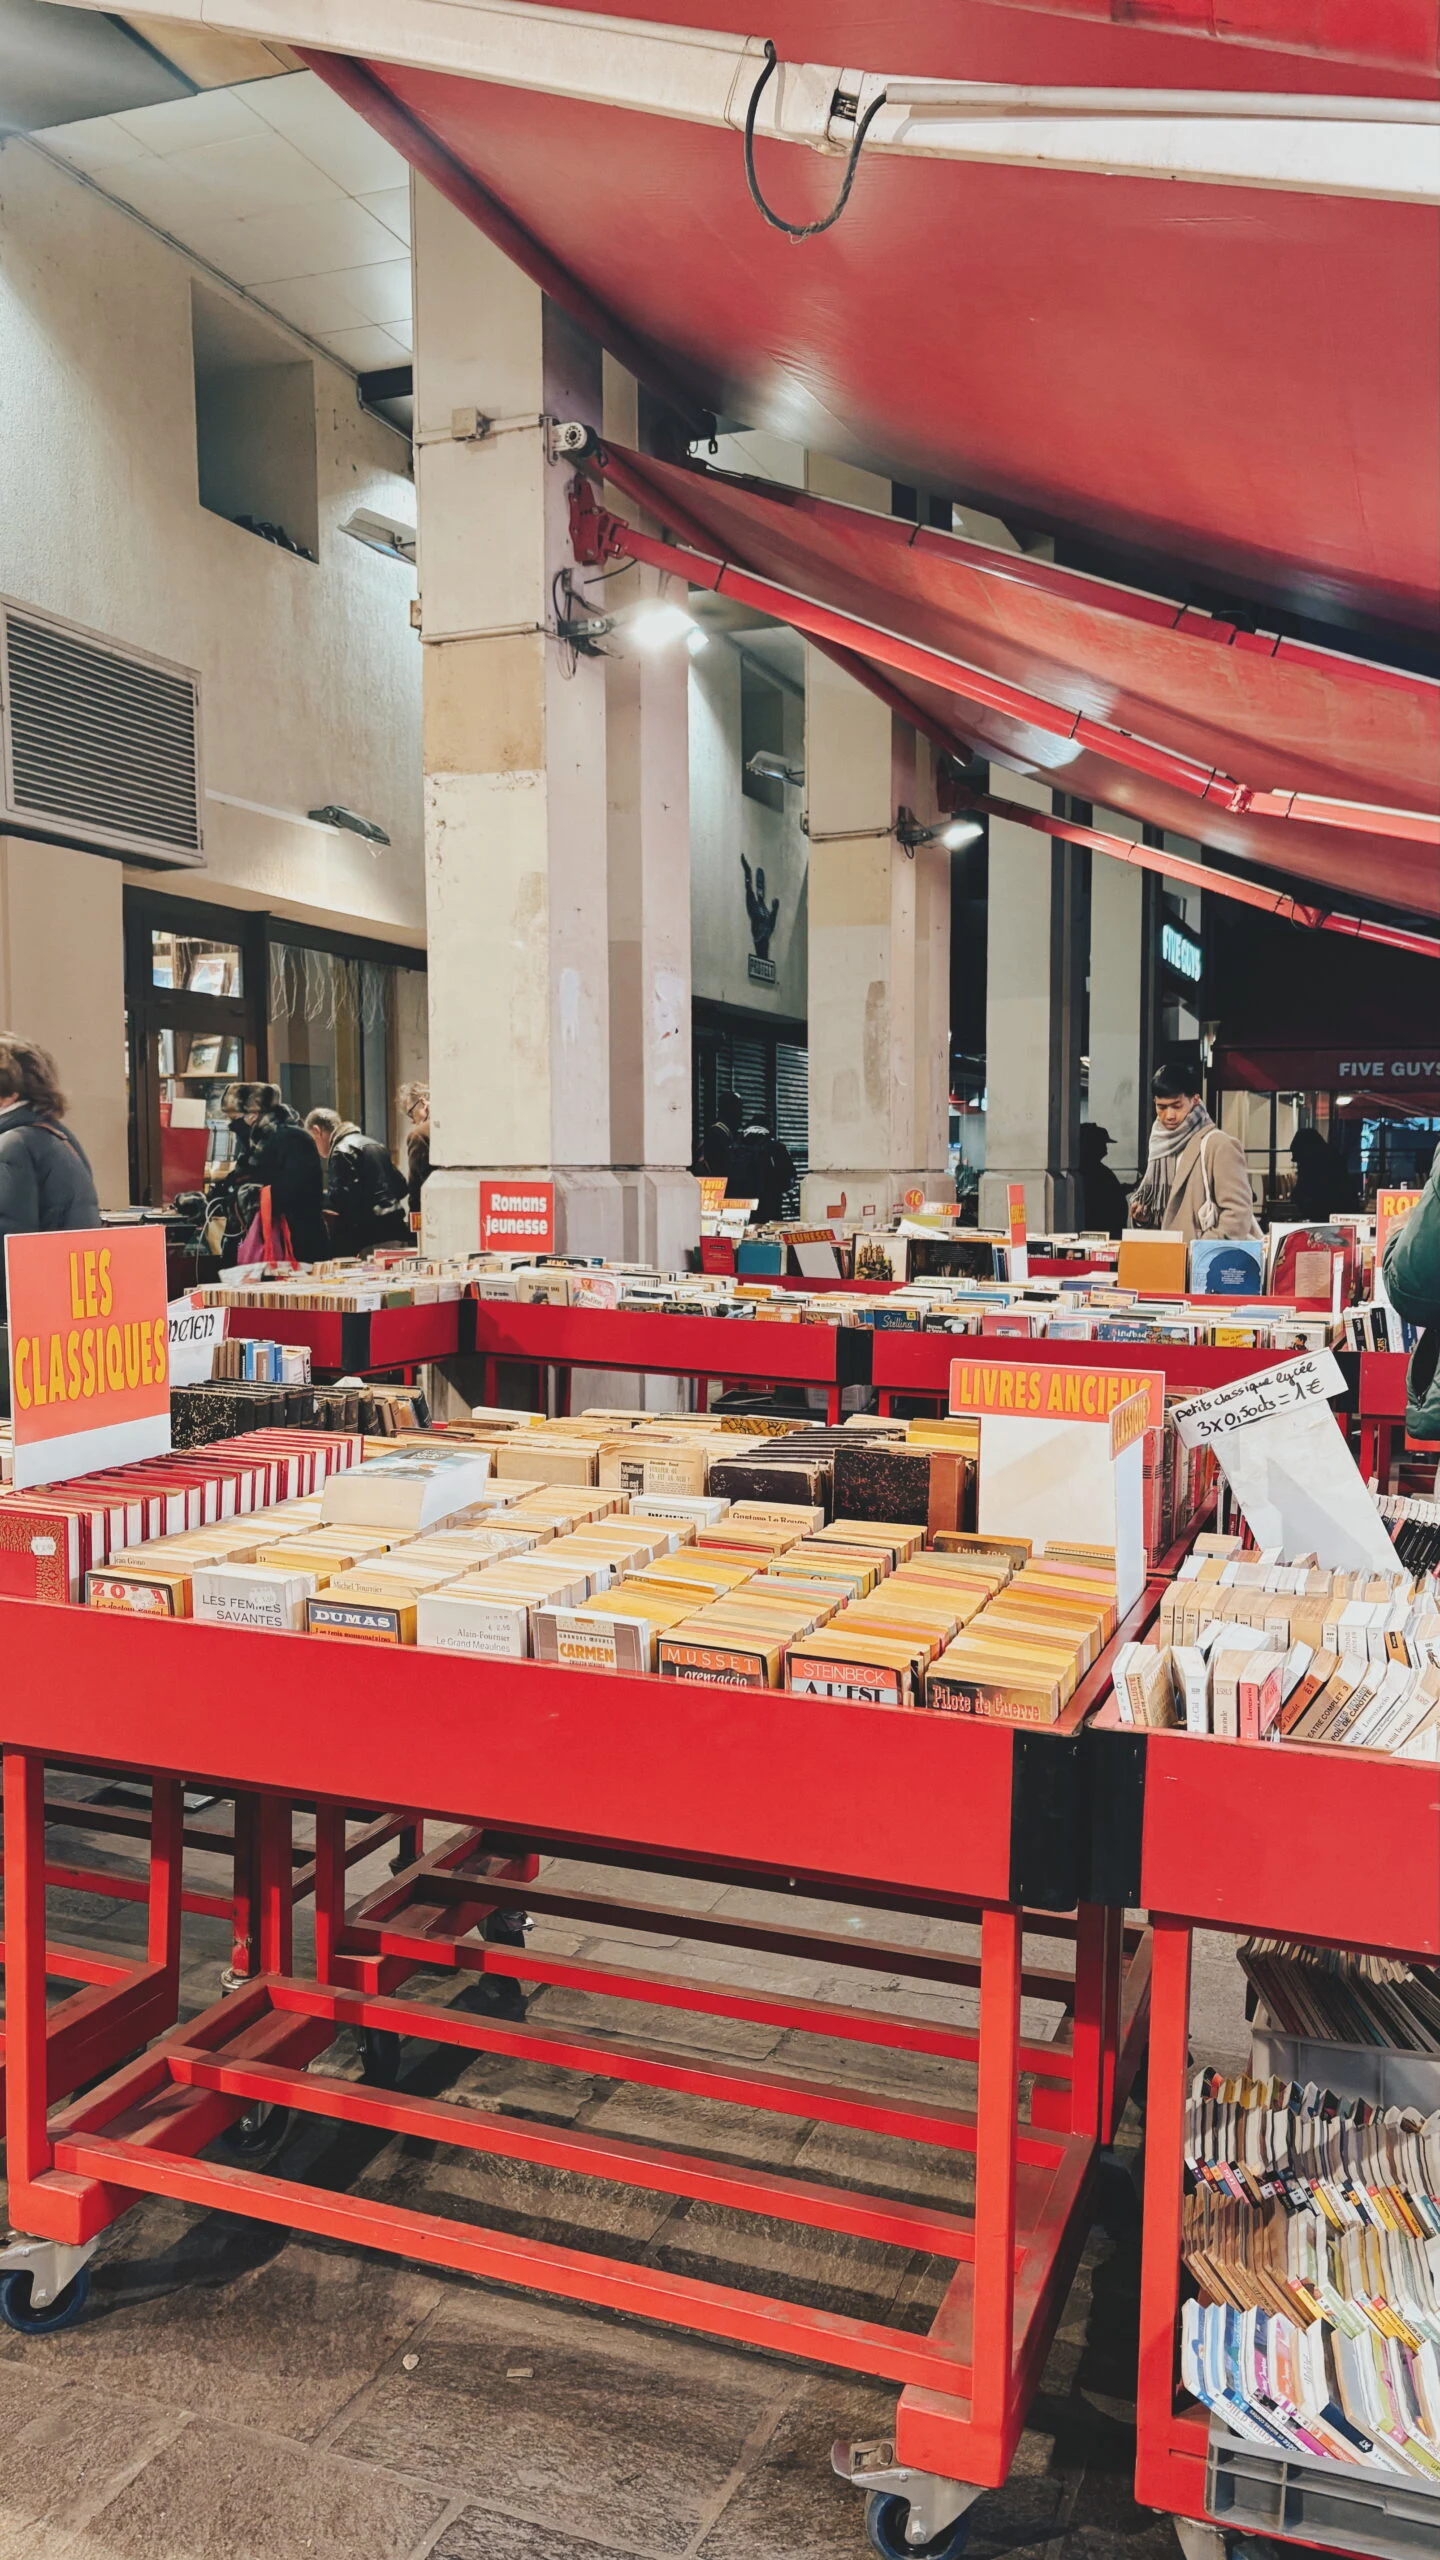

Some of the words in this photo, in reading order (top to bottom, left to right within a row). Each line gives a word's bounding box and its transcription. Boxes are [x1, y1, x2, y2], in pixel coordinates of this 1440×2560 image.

[1339, 1062, 1384, 1076] FIVE
[491, 1193, 547, 1213] Romans
[485, 1214, 548, 1237] jeunesse
[787, 1230, 833, 1243] JEUNESSE
[69, 1247, 113, 1320] LES
[168, 1313, 215, 1343] NCIEN
[14, 1317, 166, 1410] CLASSIQUES
[960, 1367, 1041, 1410] LIVRES
[92, 1581, 166, 1605] ZOA
[202, 1594, 226, 1607] LES
[216, 1609, 282, 1627] SAVANTES
[315, 1609, 391, 1628] DUMAS
[436, 1637, 446, 1645] Le
[447, 1638, 471, 1648] Grand
[457, 1628, 510, 1643] Alain-Fournier
[559, 1642, 615, 1663] CARMEN
[667, 1648, 754, 1672] MUSSET
[803, 1661, 886, 1687] STEINBECK
[932, 1684, 971, 1712] Pilote
[974, 1688, 990, 1715] de
[994, 1693, 1040, 1721] Guerre
[1343, 1717, 1352, 1727] DE
[1350, 1689, 1374, 1717] CAROTTE
[1307, 1717, 1325, 1738] EATRE
[1320, 1692, 1344, 1720] COMPLET
[1333, 1711, 1349, 1730] JULES
